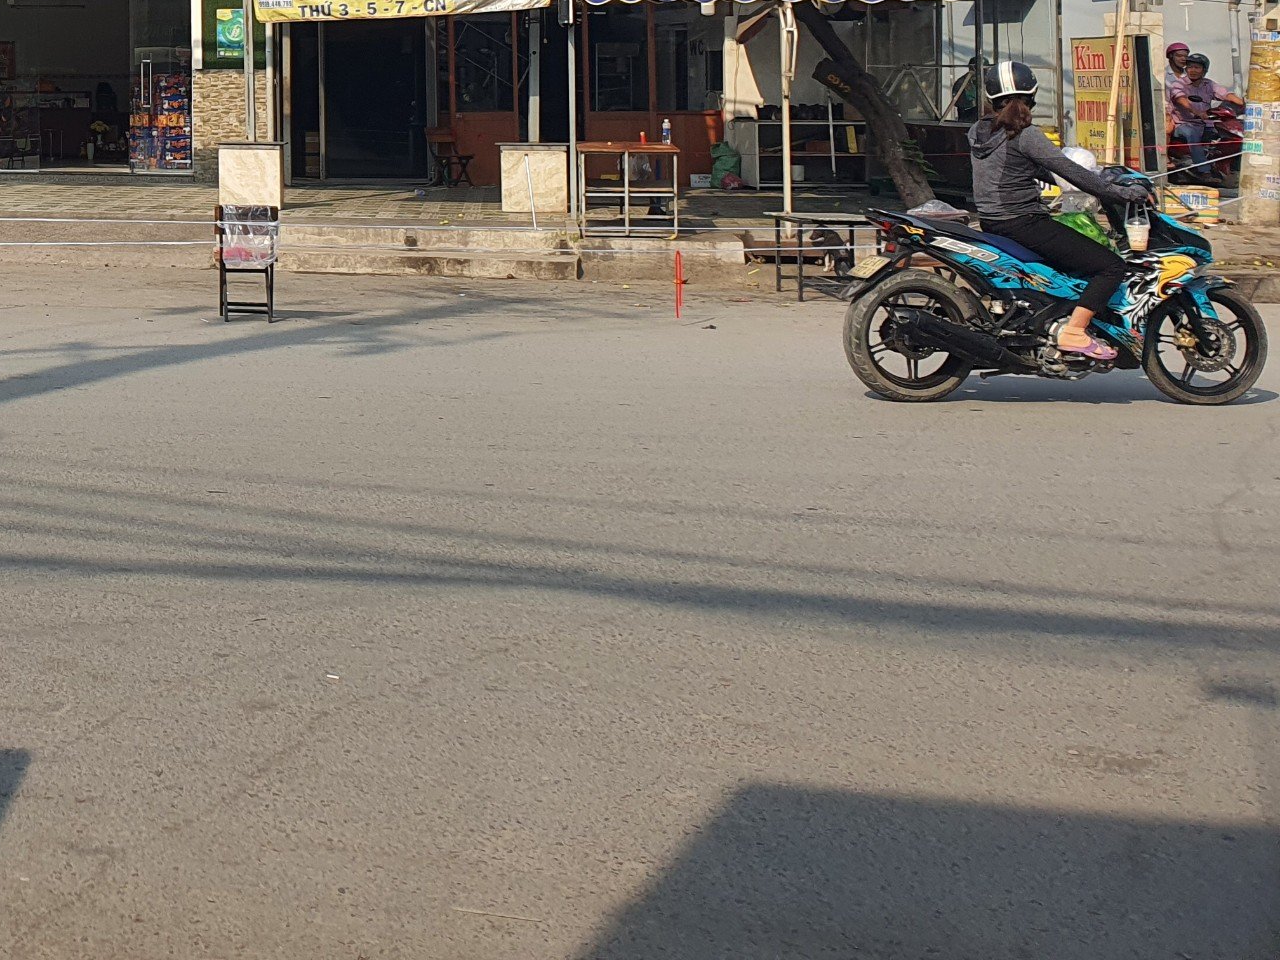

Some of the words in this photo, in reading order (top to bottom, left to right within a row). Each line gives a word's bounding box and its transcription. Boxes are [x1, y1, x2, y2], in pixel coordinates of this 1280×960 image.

[298, 0, 332, 18] THỨ
[338, 3, 349, 16] 3
[367, 2, 376, 15] 5
[395, 0, 405, 14] 7
[1075, 44, 1106, 70] Kim
[1077, 76, 1102, 88] BEAUTY
[1089, 127, 1106, 140] SÁNG
[929, 236, 1000, 263] 150
